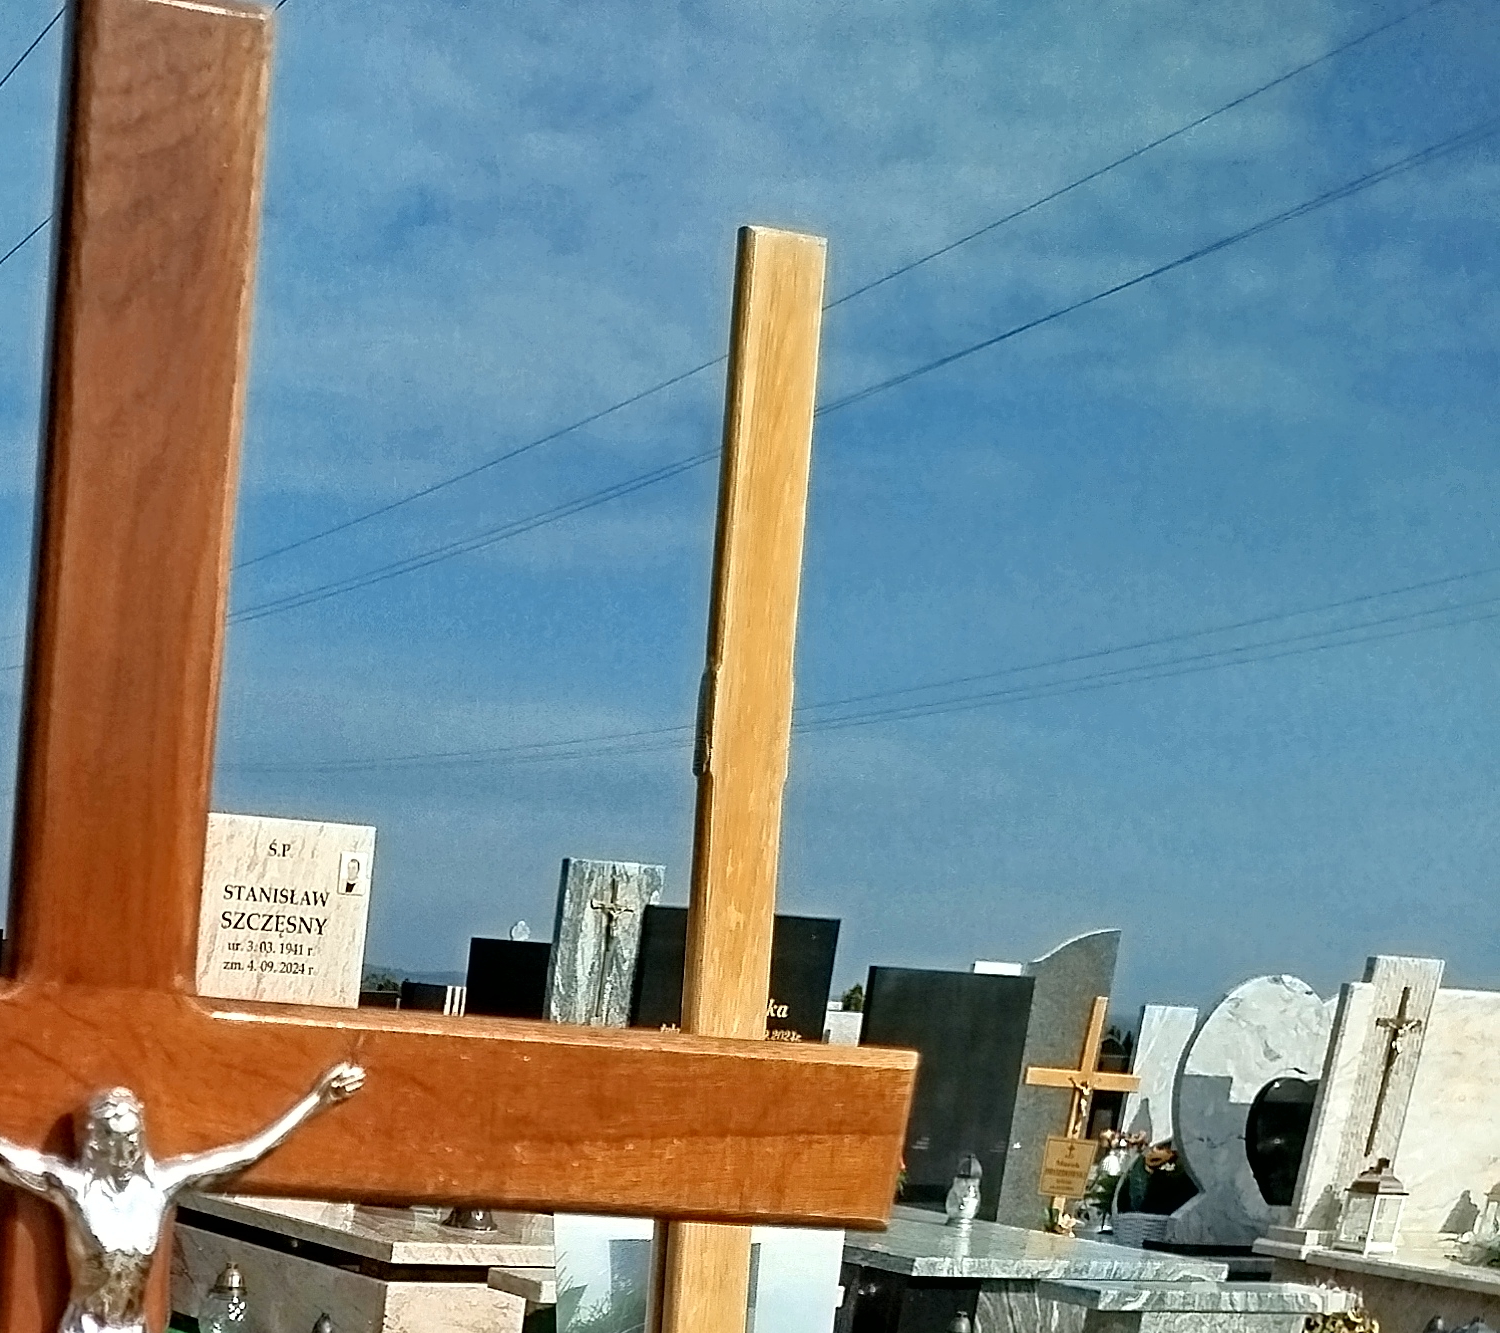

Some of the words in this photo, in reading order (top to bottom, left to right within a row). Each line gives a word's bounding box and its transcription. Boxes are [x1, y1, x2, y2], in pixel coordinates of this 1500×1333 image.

[223, 884, 330, 907] STANISŁAW
[221, 911, 328, 939] SZCZĘSNY
[223, 961, 244, 971] zm.
[280, 962, 305, 975] 2024
